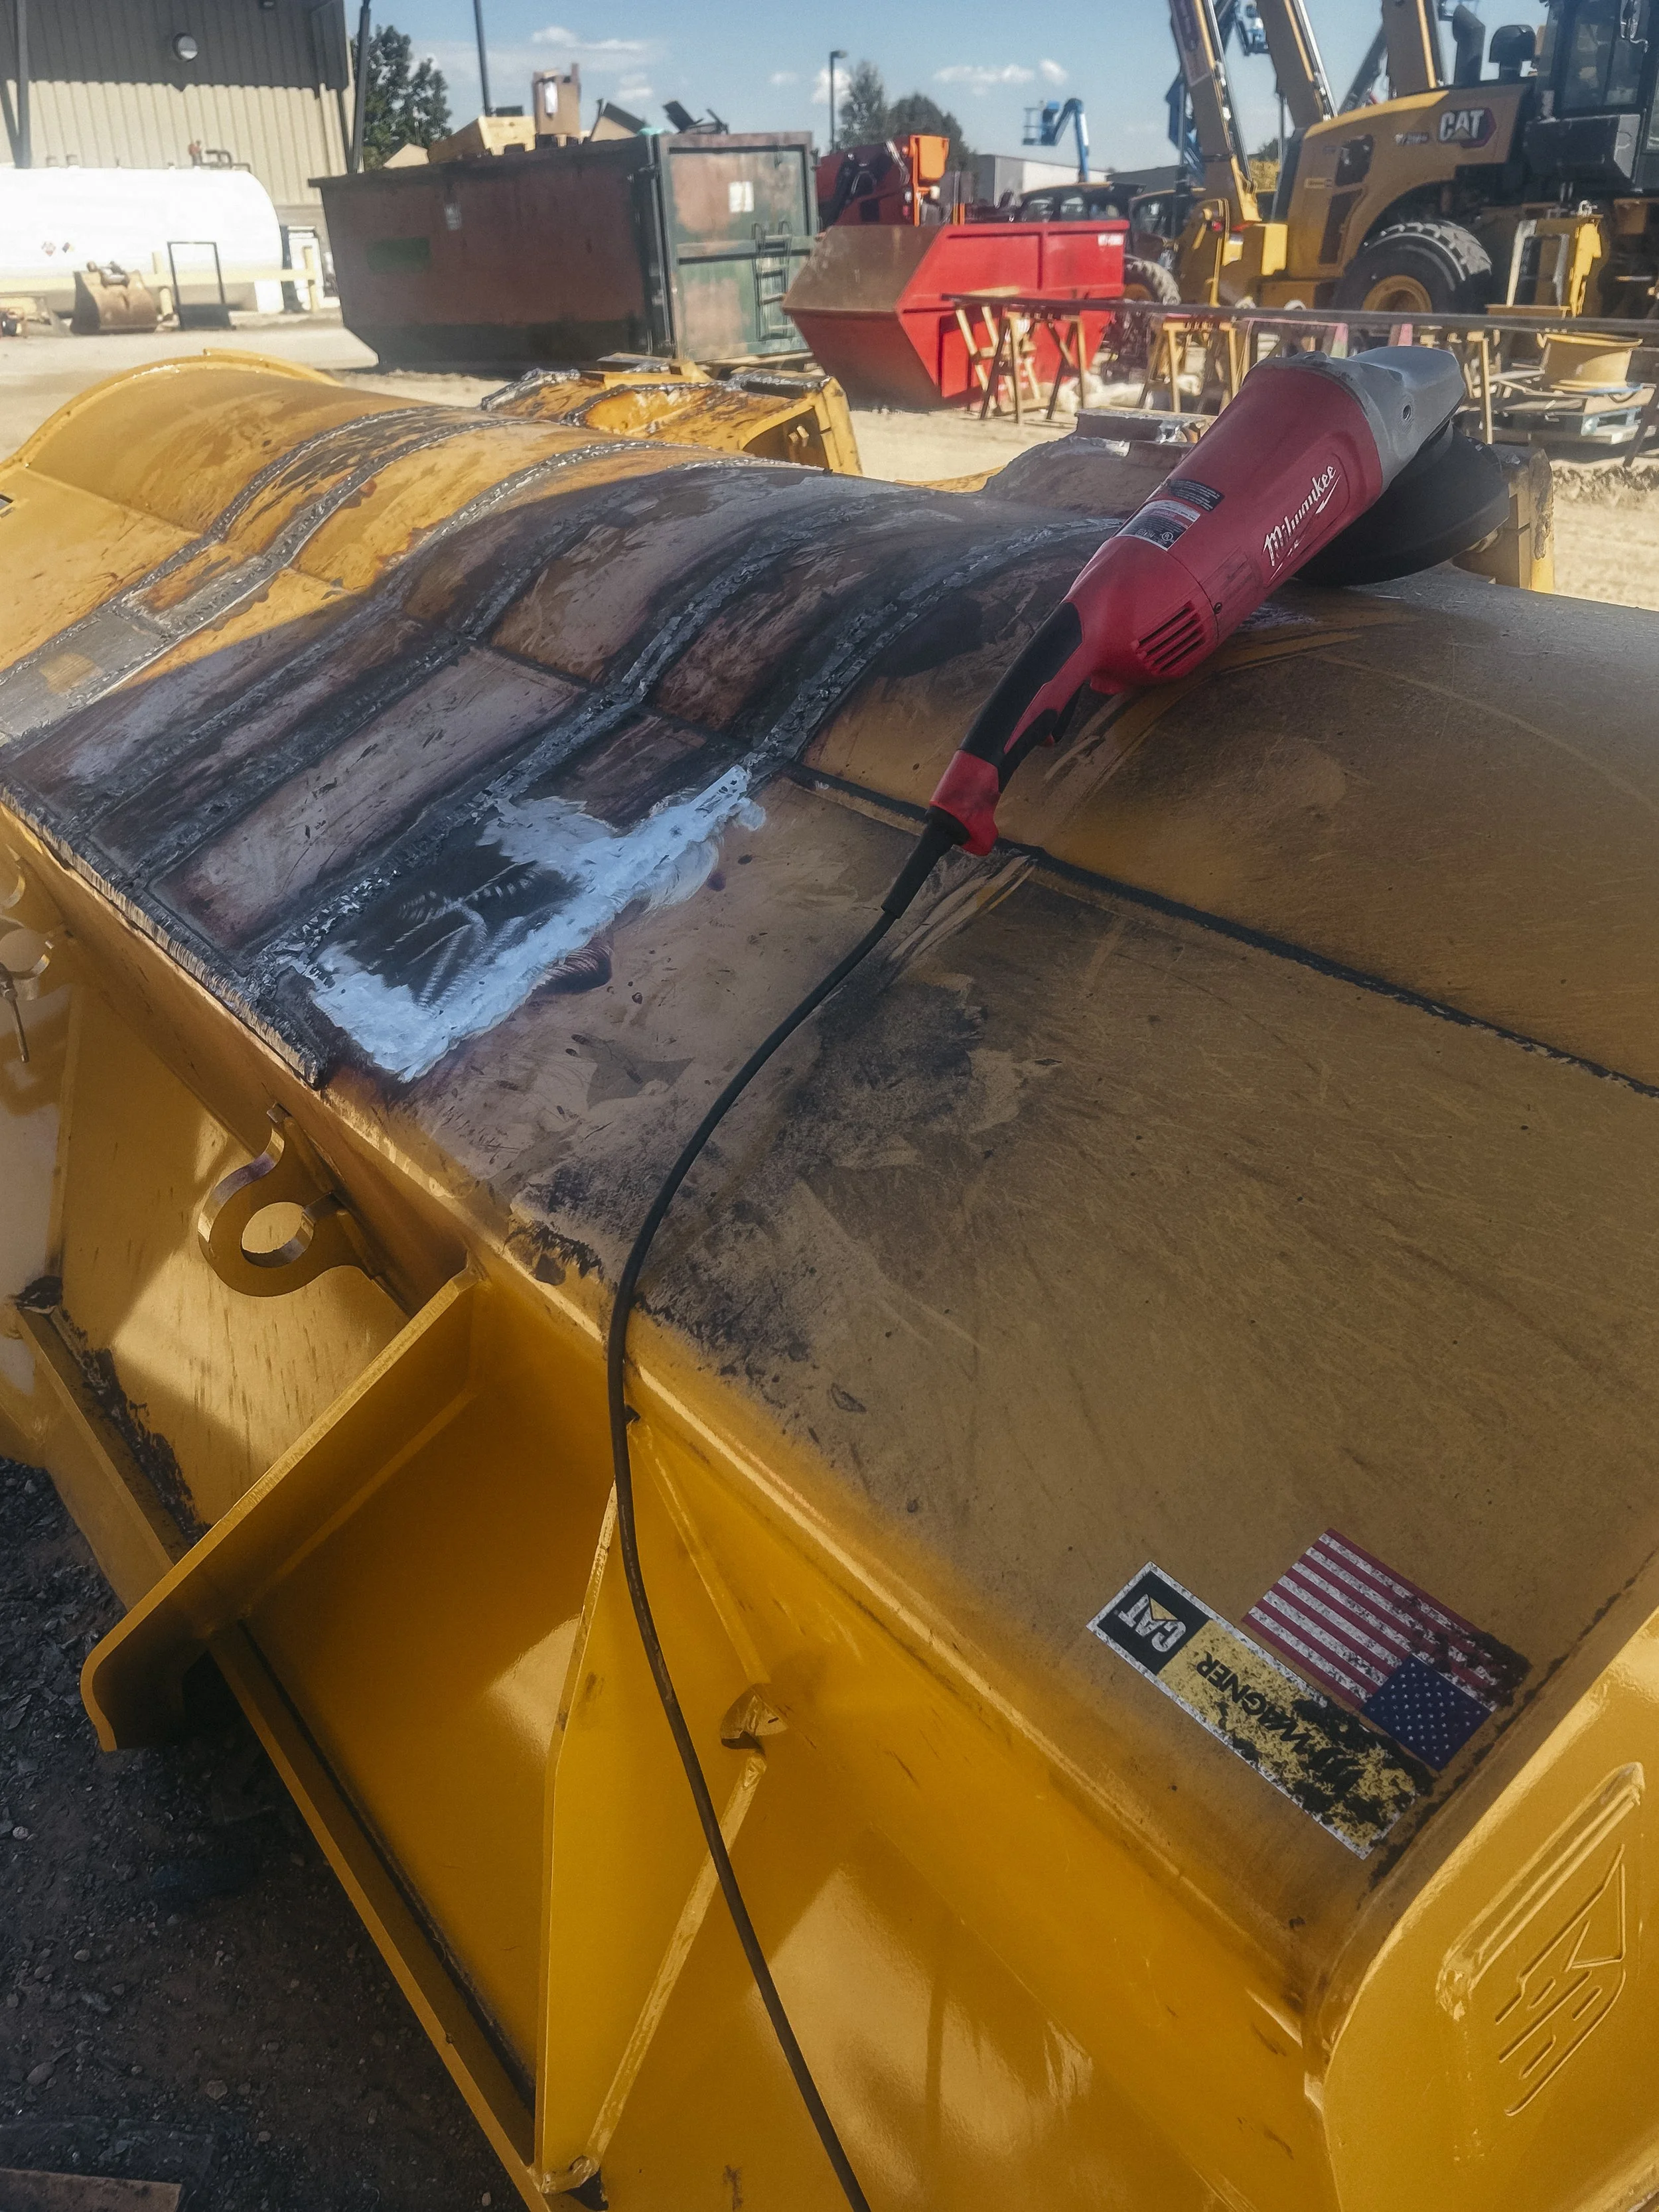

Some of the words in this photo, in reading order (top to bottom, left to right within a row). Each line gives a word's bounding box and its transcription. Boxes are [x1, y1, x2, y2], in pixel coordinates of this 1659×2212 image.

[1439, 109, 1485, 141] CAT
[1118, 1594, 1187, 1652] CAT
[1196, 1651, 1312, 1755] WAGNER
